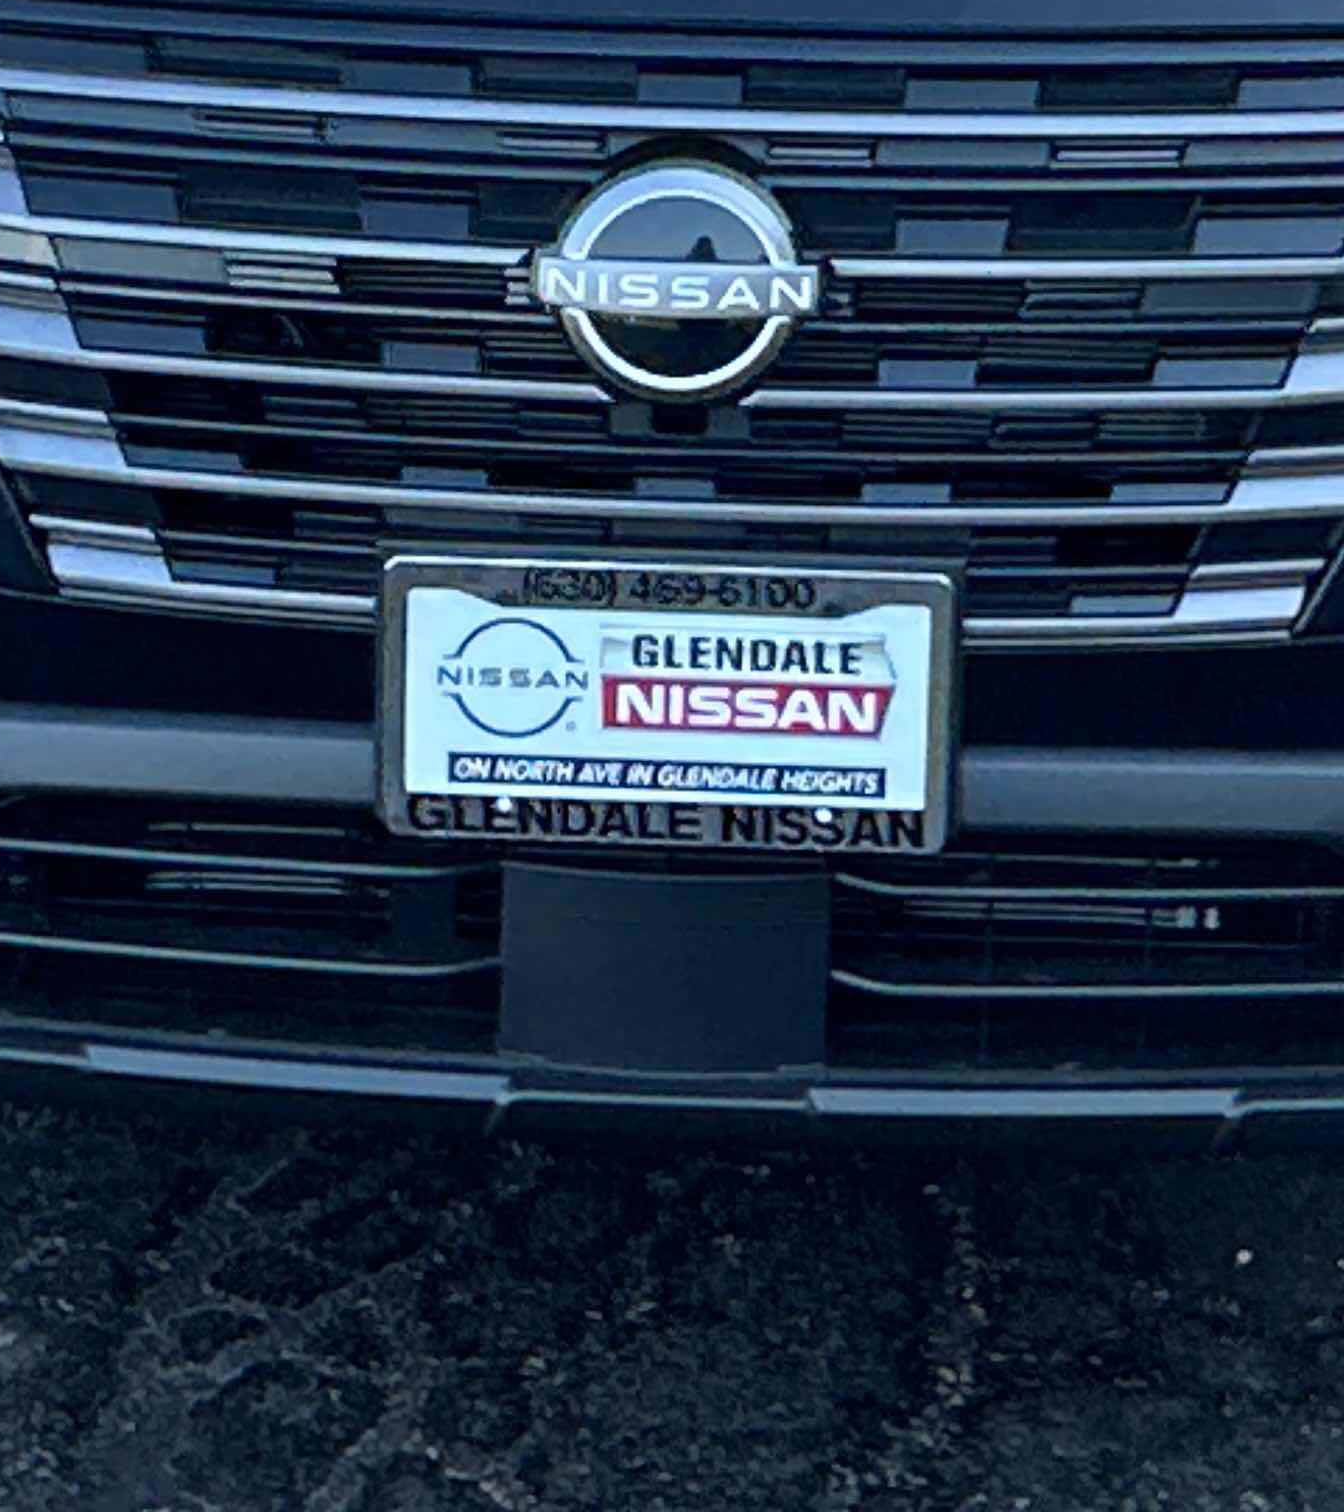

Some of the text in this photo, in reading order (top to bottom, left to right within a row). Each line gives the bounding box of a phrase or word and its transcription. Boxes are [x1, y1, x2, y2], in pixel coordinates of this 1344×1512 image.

[544, 266, 812, 311] NISSAN
[631, 634, 862, 676] GLENDALE
[437, 666, 589, 690] NISSAN
[615, 683, 877, 733] NISSAN
[455, 756, 879, 795] ON NORTH AVE IN GLENDALE HEIGHTS
[409, 794, 925, 848] GLENDALE NISSAN
